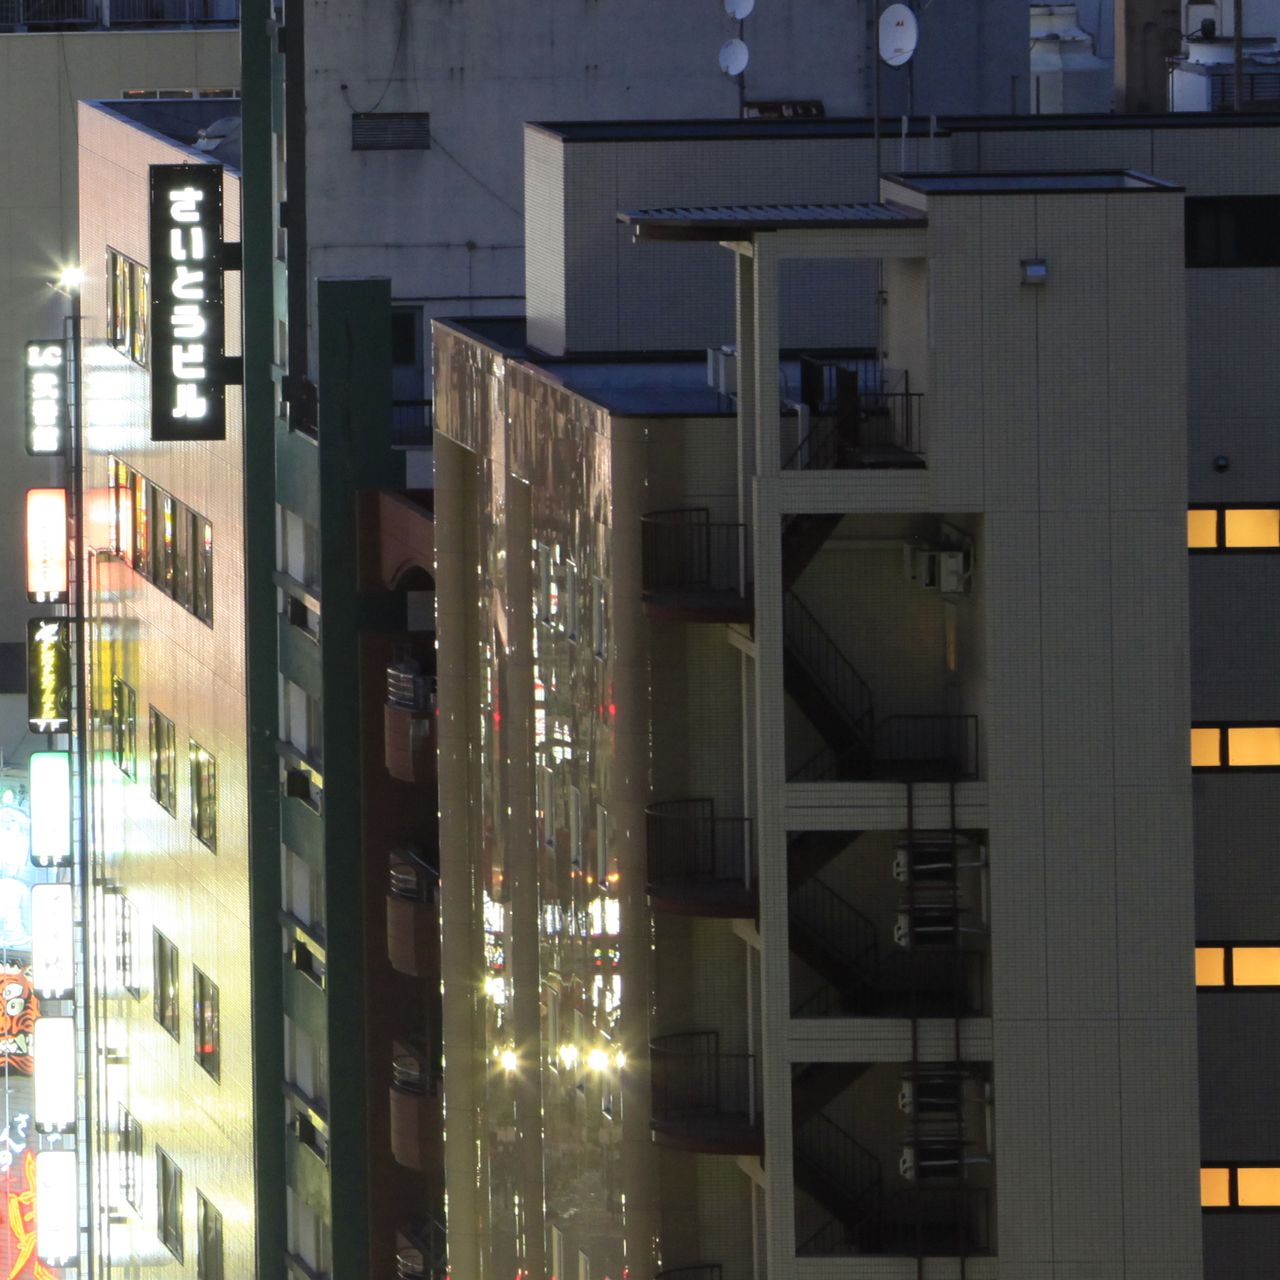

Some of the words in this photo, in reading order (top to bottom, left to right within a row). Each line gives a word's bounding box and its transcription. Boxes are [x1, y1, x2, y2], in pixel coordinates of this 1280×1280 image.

[168, 186, 206, 419] さいとうビル
